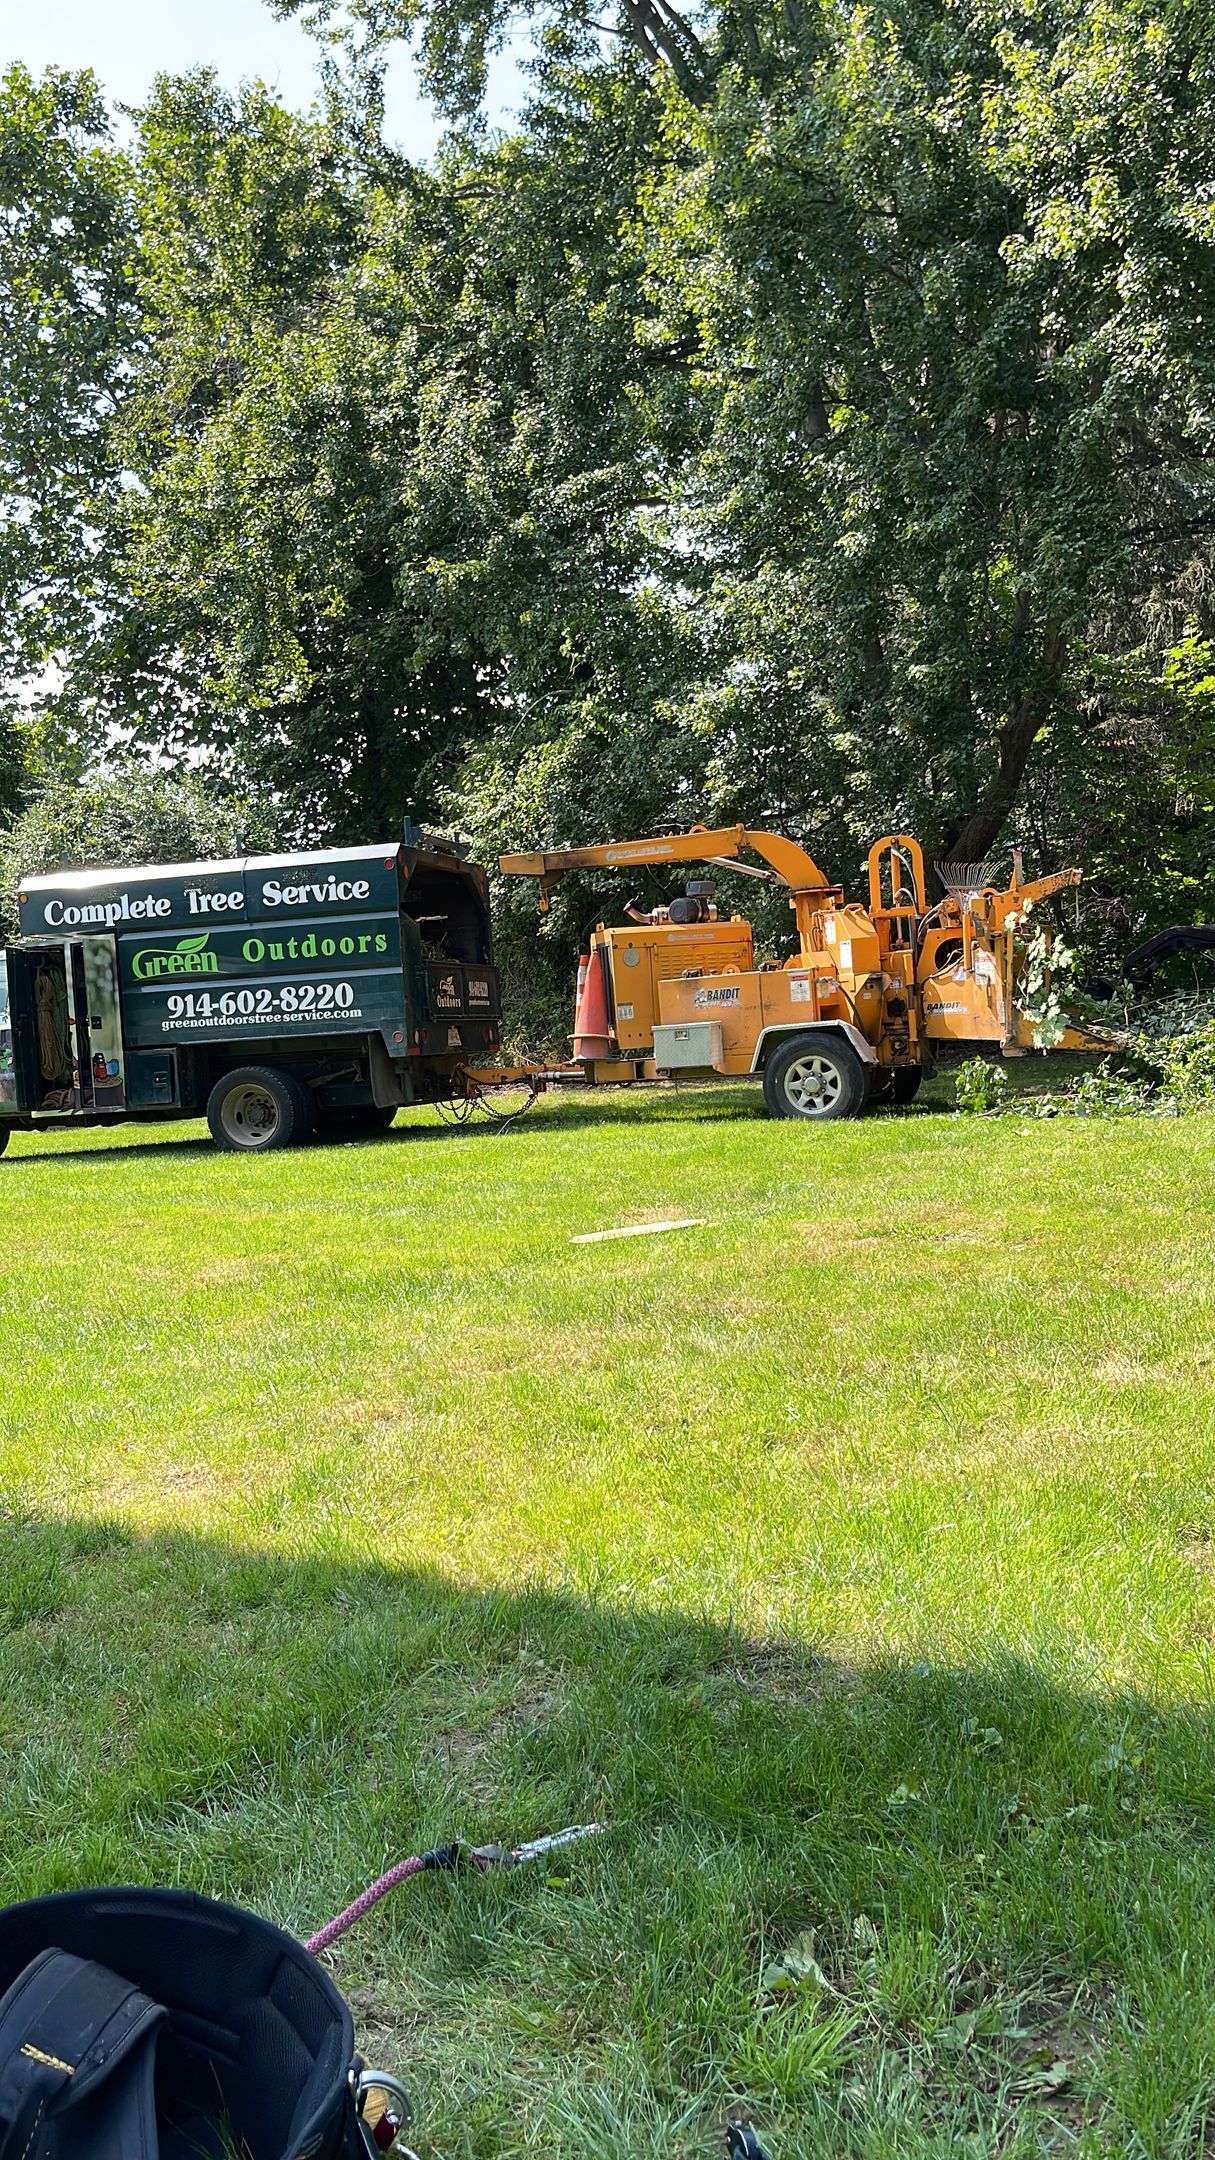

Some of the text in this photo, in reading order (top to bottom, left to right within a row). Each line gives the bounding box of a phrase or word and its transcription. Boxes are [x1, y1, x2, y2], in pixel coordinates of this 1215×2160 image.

[44, 875, 370, 927] Complete Tree Service
[132, 933, 388, 980] Green Outdoors
[166, 982, 355, 1019] 914-602-8220
[706, 987, 741, 1001] BANDIT
[927, 1001, 961, 1011] BANDIT
